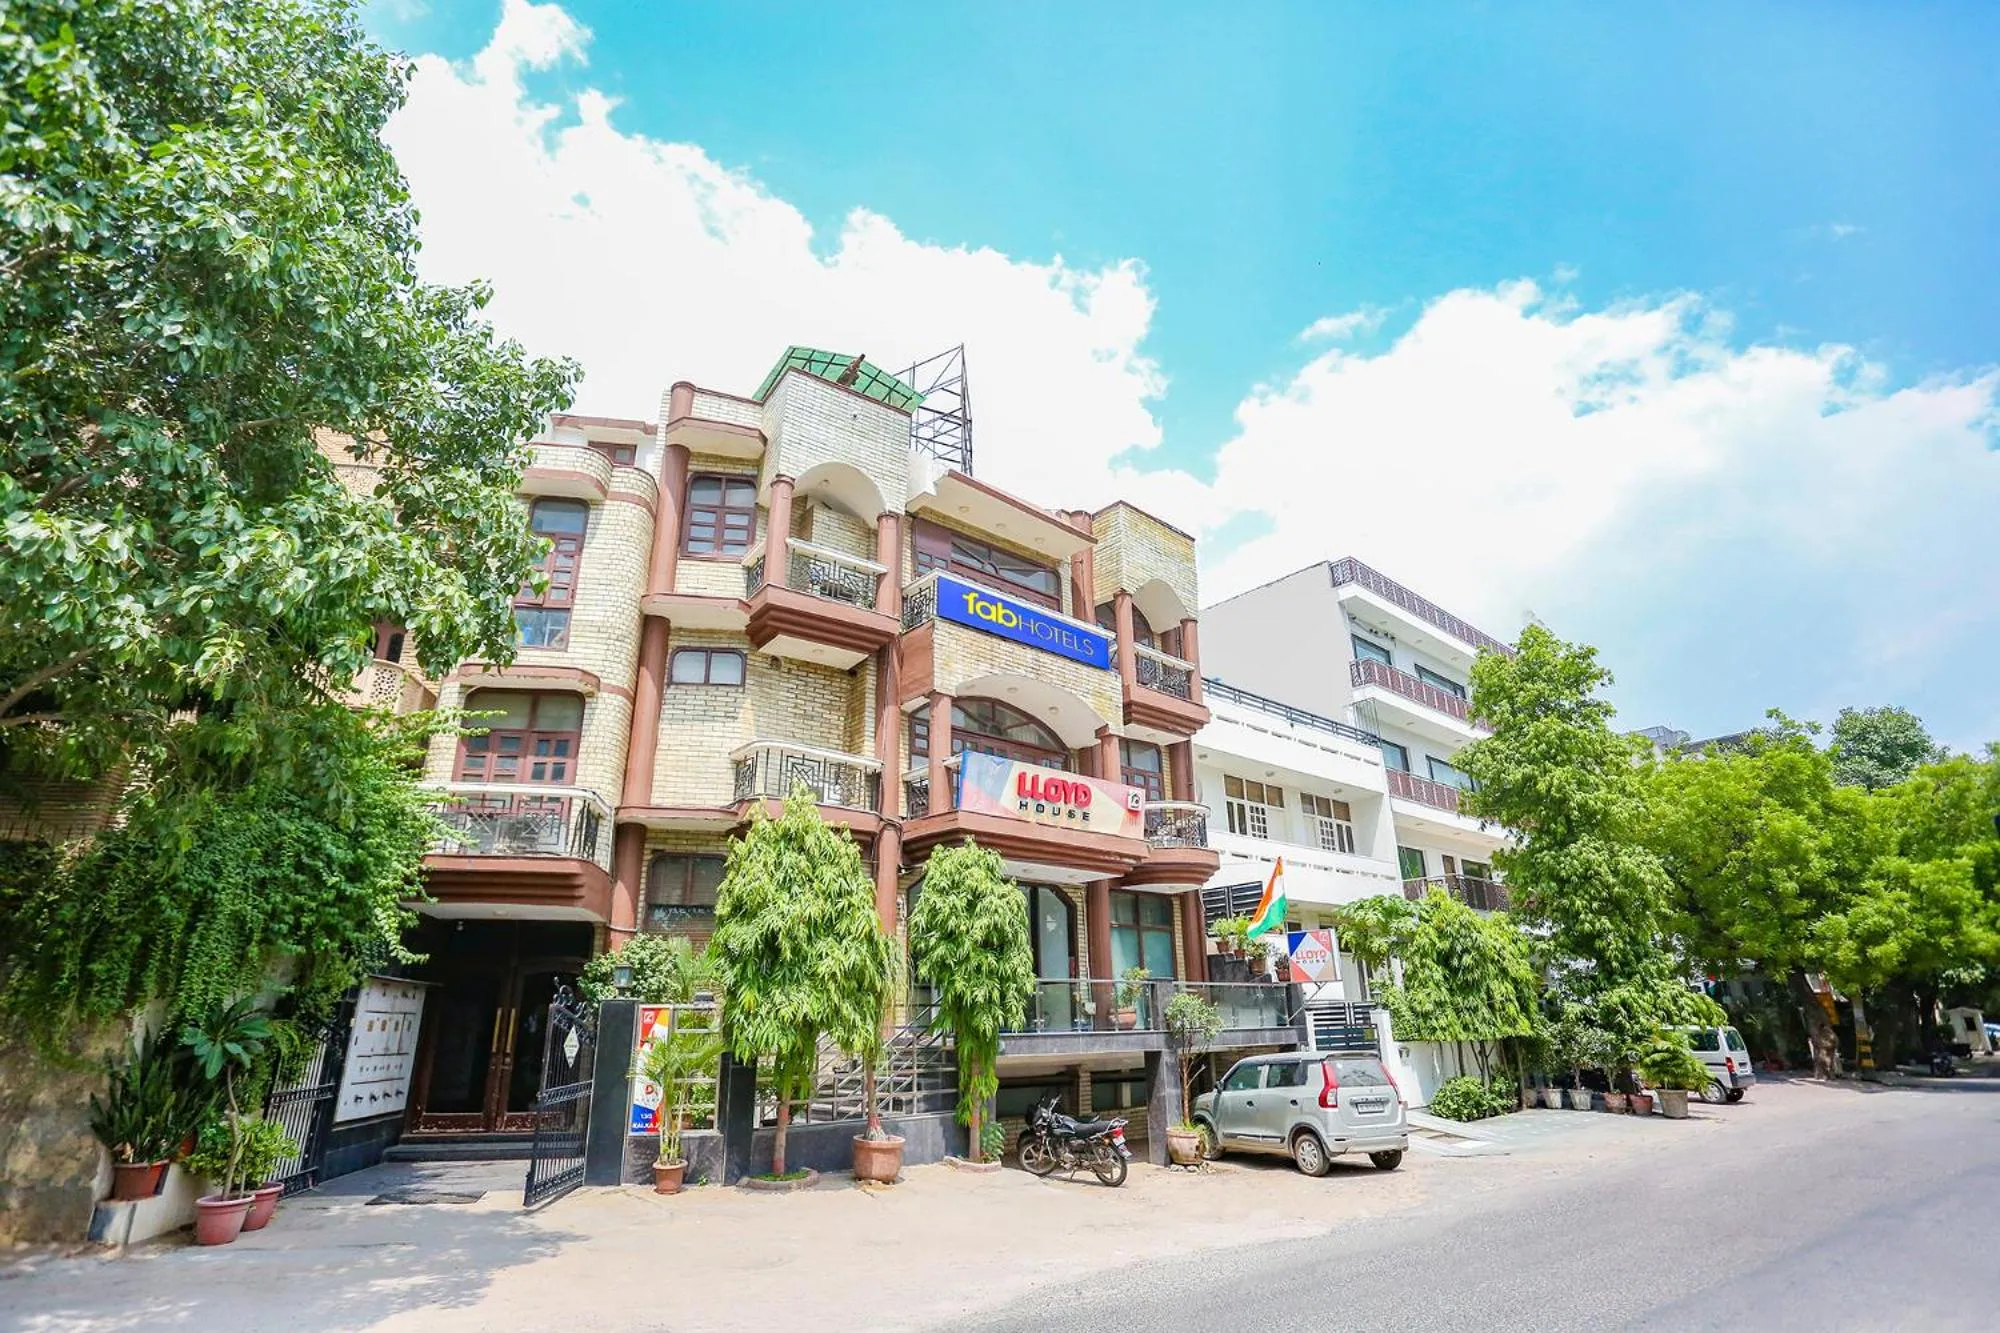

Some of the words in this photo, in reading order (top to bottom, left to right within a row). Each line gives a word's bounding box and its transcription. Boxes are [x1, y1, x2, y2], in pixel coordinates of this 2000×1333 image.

[1017, 771, 1093, 809] LLOYD
[1019, 800, 1091, 821] HOUSE
[1295, 950, 1327, 960] LLOYD
